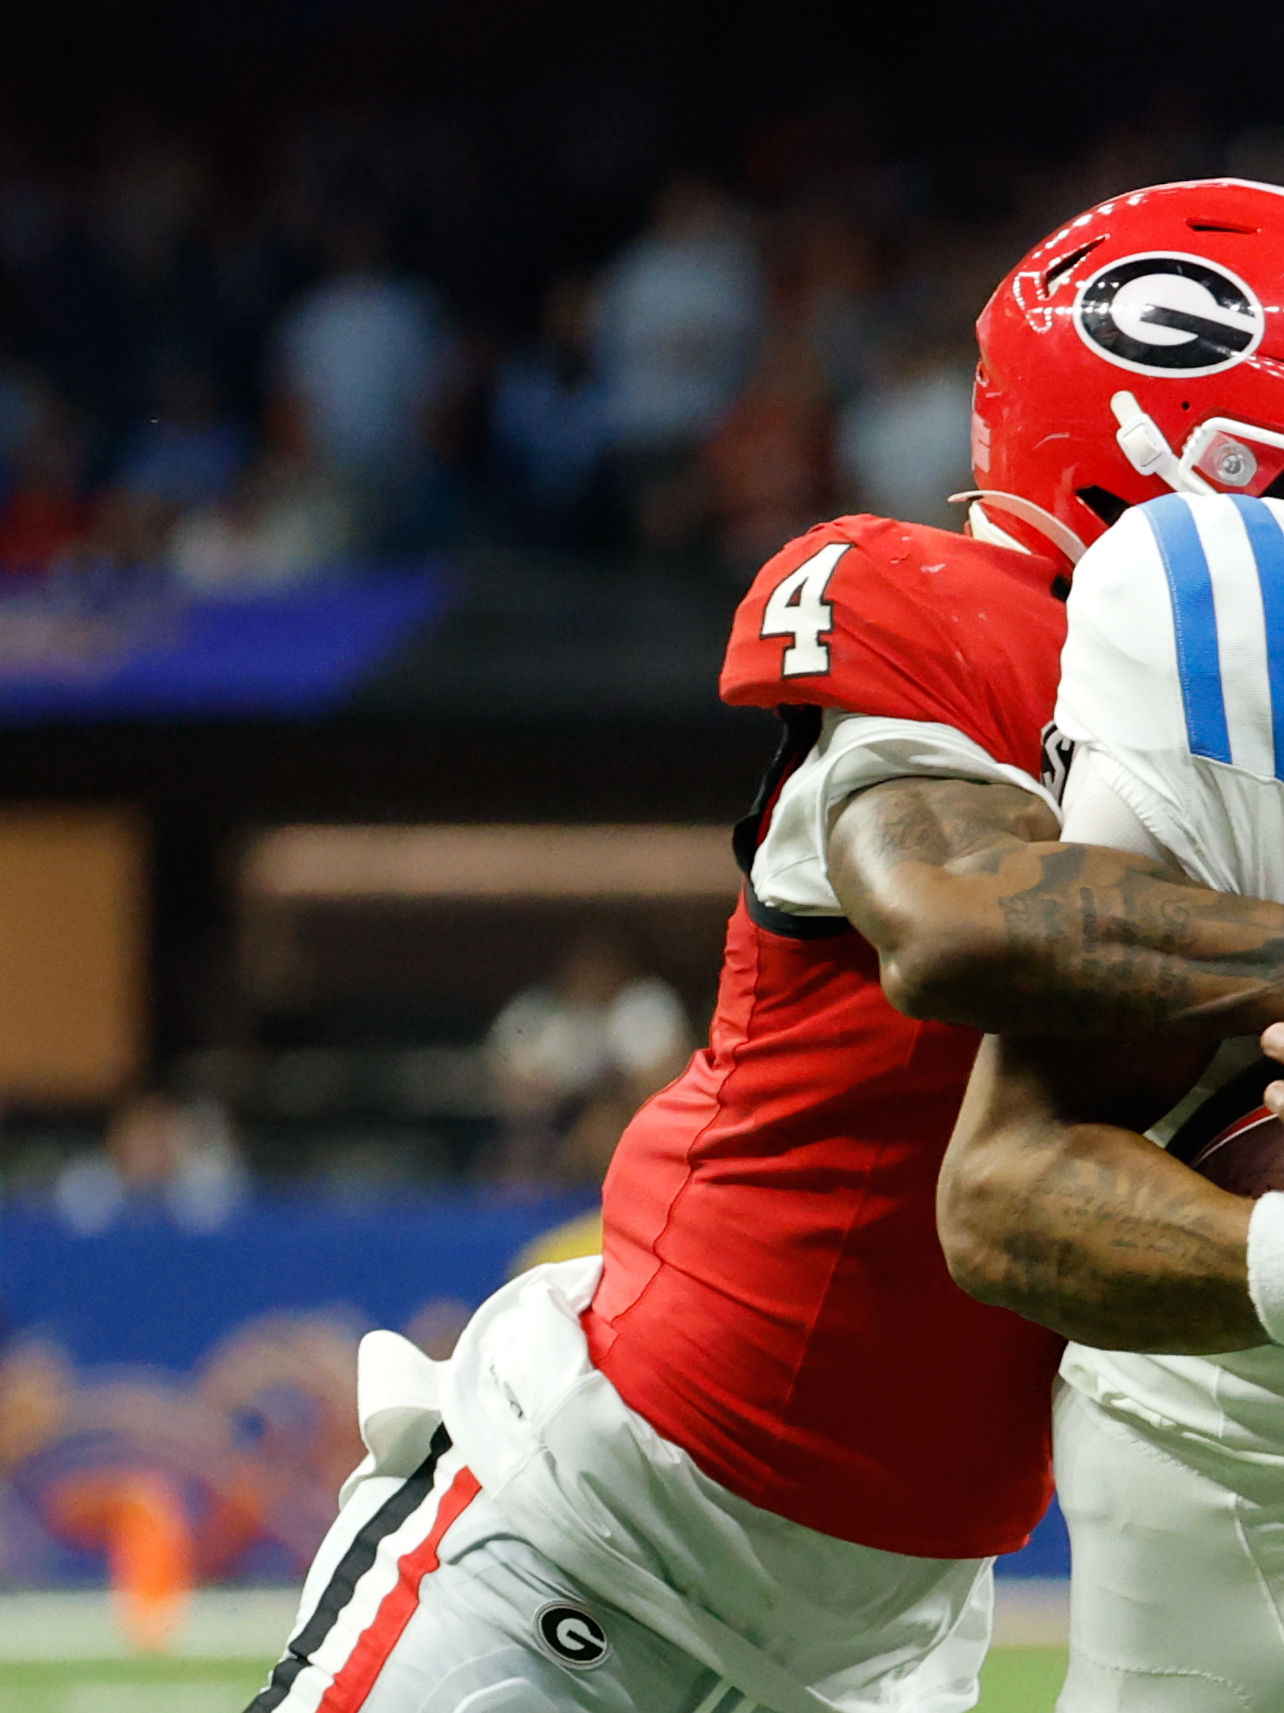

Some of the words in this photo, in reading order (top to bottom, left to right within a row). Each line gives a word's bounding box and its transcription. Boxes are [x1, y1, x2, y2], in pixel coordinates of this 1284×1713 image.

[1079, 256, 1258, 371] G
[761, 541, 853, 680] 4
[540, 1606, 606, 1662] G
